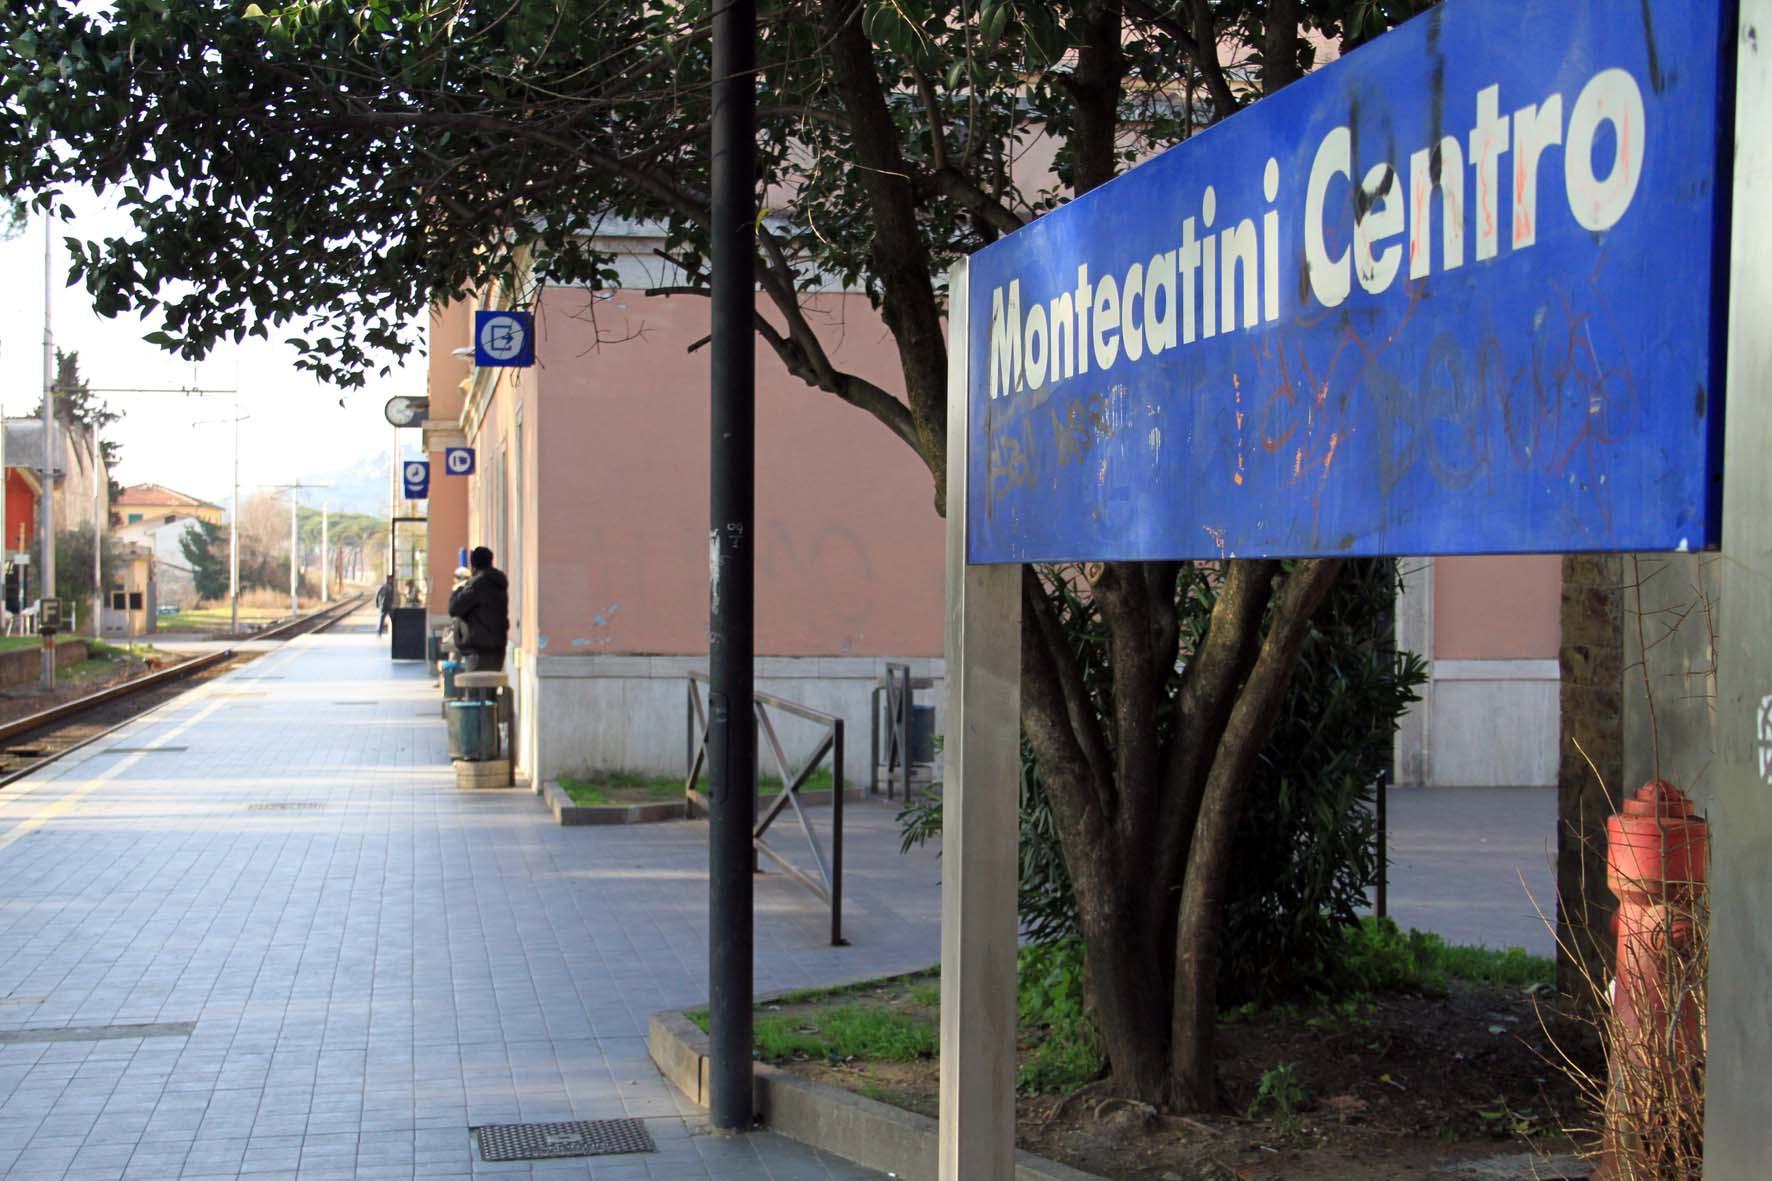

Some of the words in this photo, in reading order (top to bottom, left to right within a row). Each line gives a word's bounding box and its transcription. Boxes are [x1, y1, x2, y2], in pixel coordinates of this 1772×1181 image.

[990, 156, 1280, 399] Montecatini
[1304, 67, 1646, 308] Centro
[43, 601, 58, 624] F
